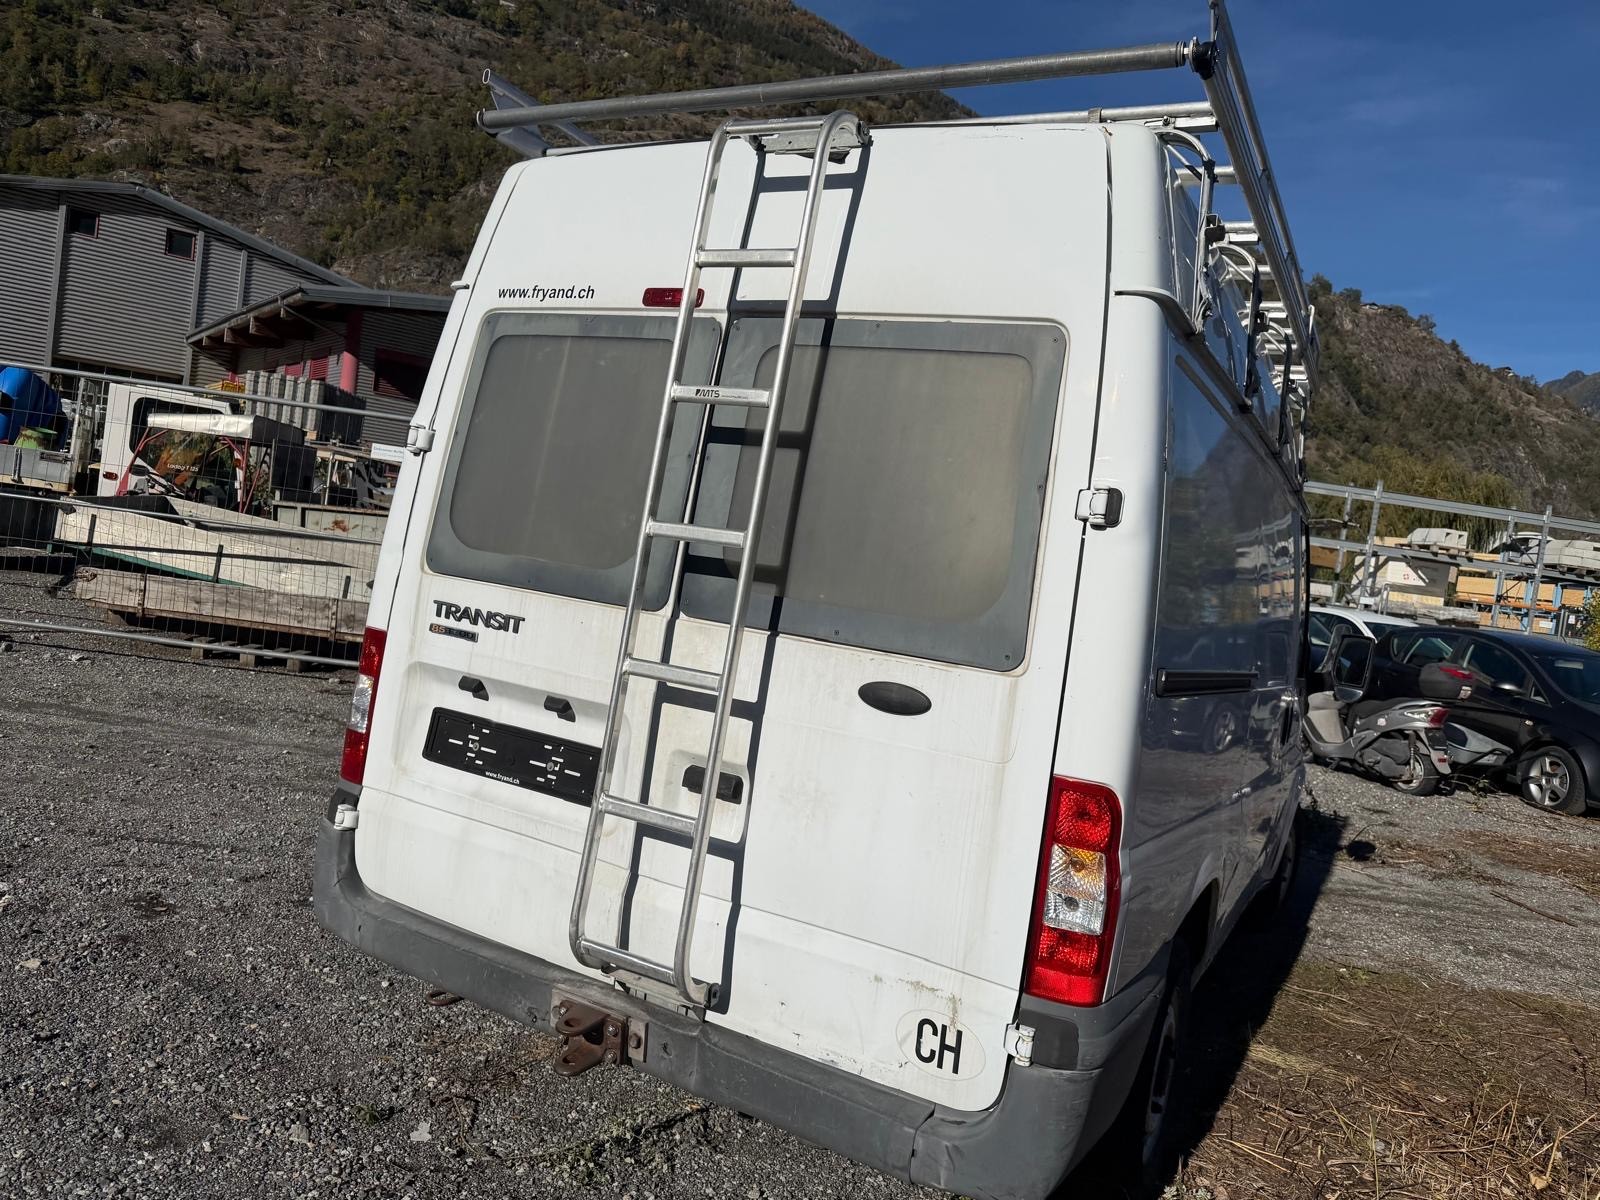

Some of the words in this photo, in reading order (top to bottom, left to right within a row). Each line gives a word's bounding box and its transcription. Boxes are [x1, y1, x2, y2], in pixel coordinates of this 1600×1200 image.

[498, 284, 595, 302] www.fryand.ch
[433, 599, 525, 634] TRANSIT
[431, 624, 446, 634] 85
[485, 771, 520, 785] www.fryand.ch
[915, 1018, 963, 1075] CH
